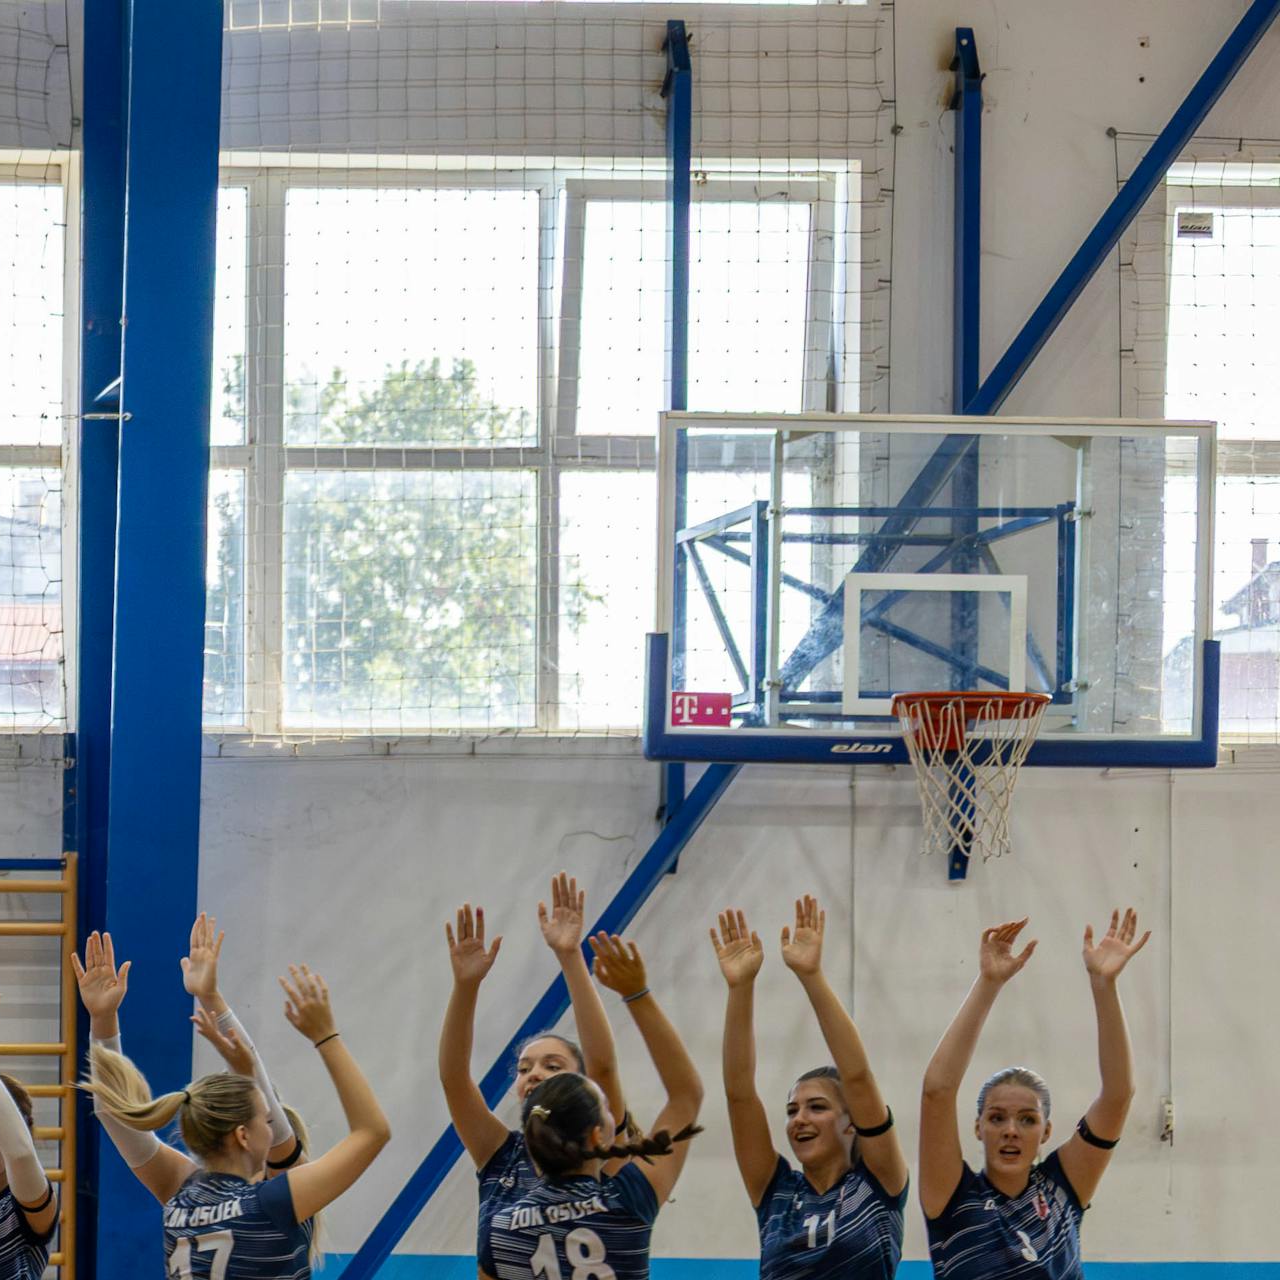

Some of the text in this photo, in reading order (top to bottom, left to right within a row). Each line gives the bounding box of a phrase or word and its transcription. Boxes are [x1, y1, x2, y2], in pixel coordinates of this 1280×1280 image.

[831, 743, 893, 753] elan
[189, 1198, 243, 1227] OSIJEK
[803, 1209, 836, 1248] 11
